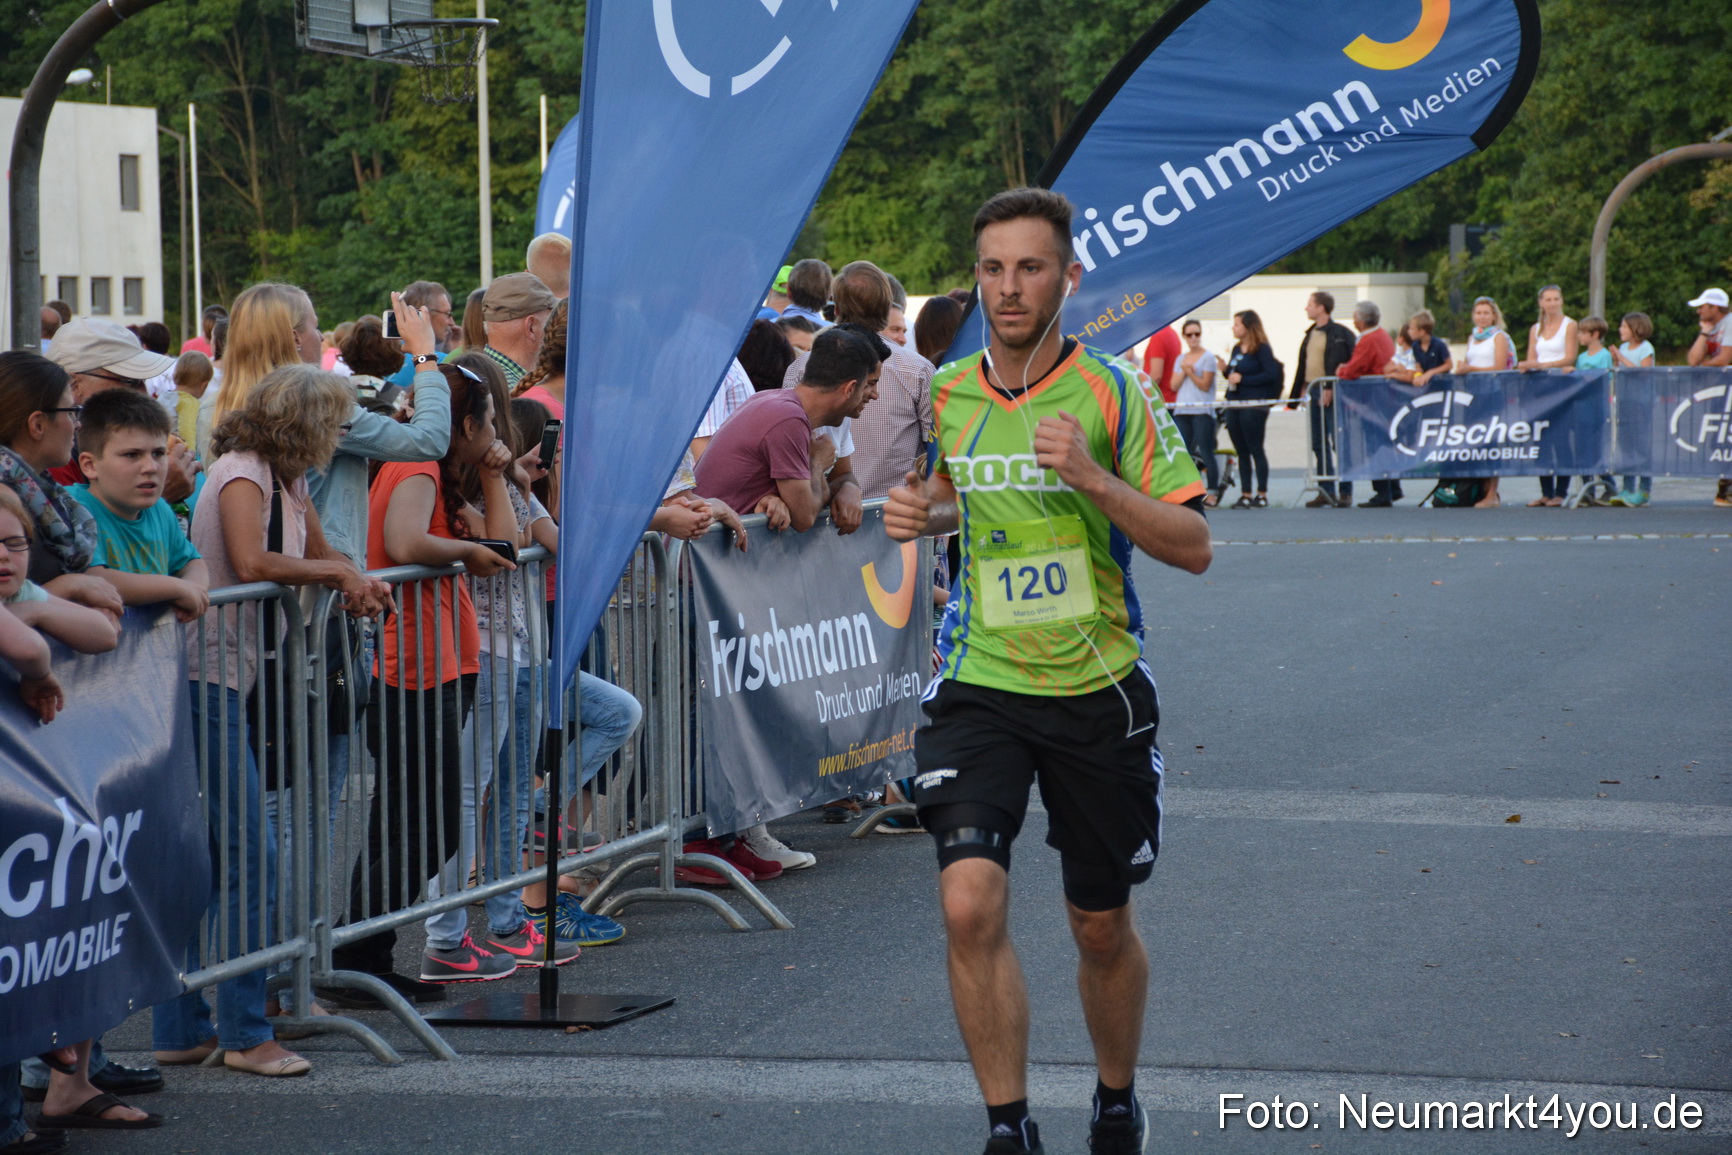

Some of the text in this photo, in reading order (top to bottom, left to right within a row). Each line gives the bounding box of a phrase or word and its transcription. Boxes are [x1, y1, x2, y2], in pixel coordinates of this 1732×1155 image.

[1257, 57, 1502, 202] Druck und Medien
[1072, 80, 1380, 273] rischmann
[1418, 415, 1549, 447] Fischer
[1424, 446, 1540, 462] AUTOMOBILE
[1709, 448, 1732, 462] AU
[997, 561, 1068, 602] 120
[1037, 605, 1057, 614] Wirth
[708, 607, 878, 698] Frischmann
[815, 682, 855, 723] Druck
[855, 674, 883, 713] und
[818, 722, 917, 777] www.frischmann-net.d
[0, 797, 143, 918] cher
[0, 912, 131, 994] OMOBILE
